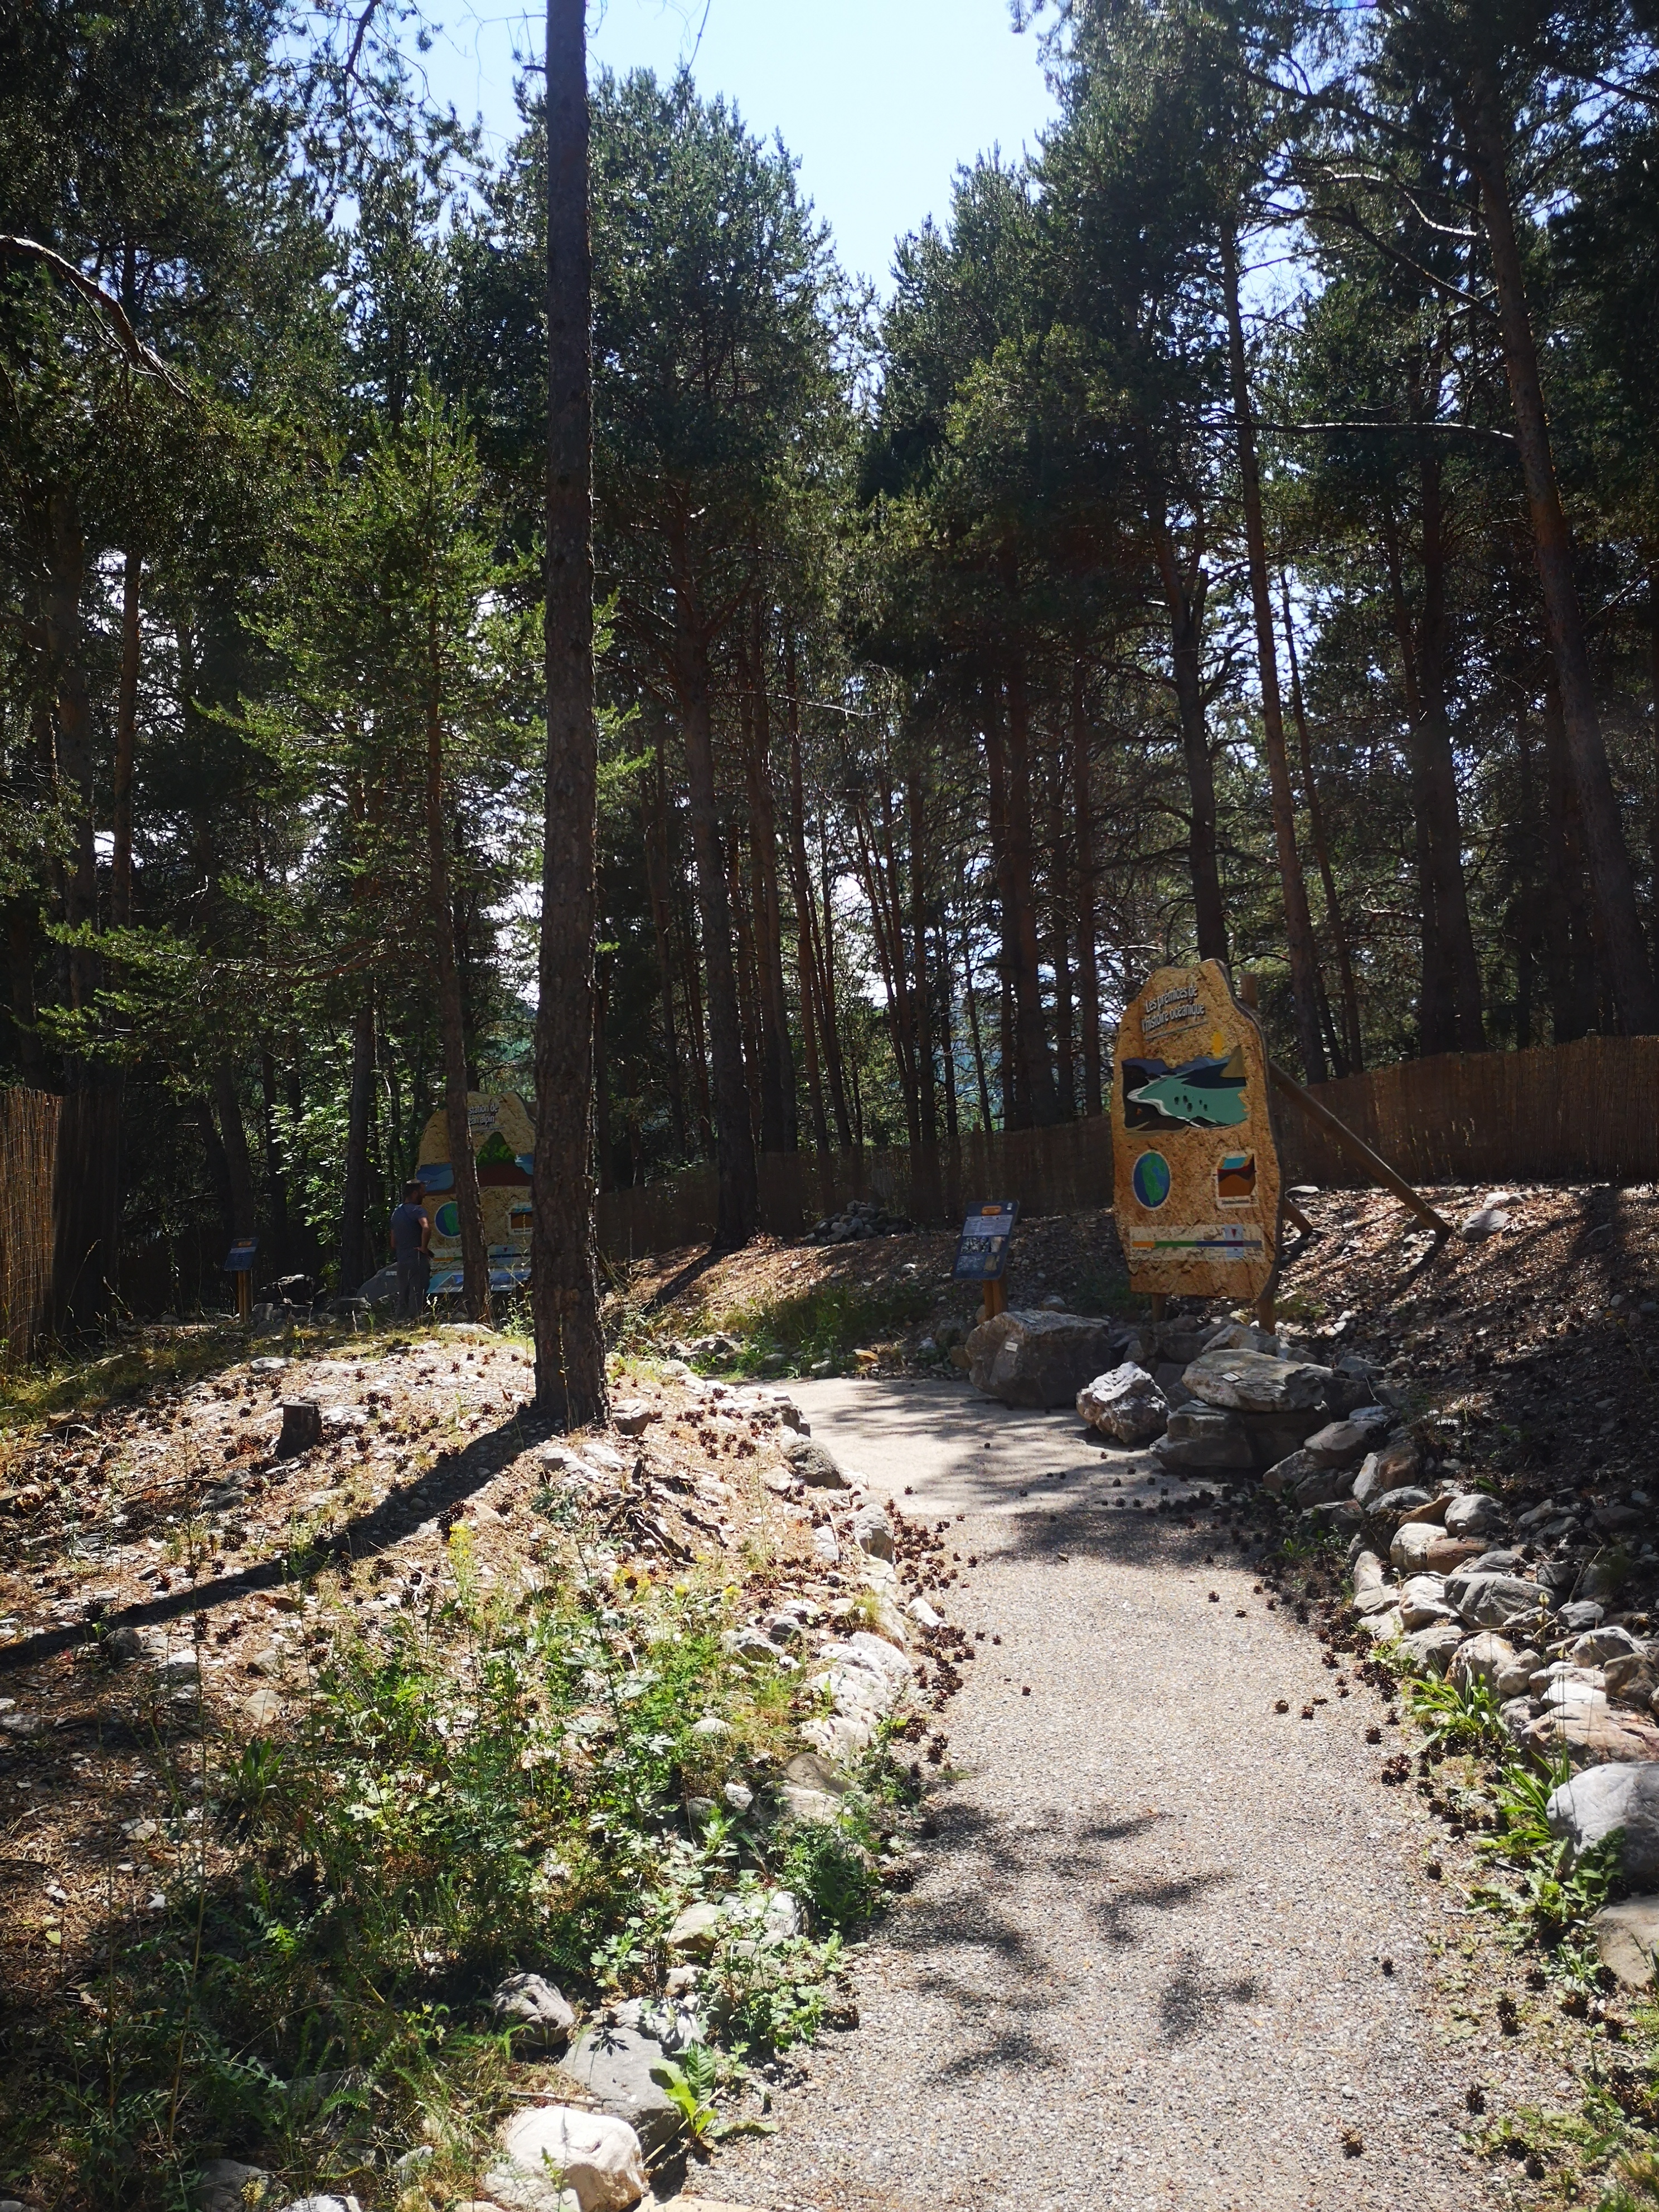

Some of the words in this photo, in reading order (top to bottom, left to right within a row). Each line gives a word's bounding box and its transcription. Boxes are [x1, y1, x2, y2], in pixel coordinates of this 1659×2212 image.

[1145, 999, 1157, 1013] Les
[1157, 987, 1187, 1011] prémices
[1189, 982, 1198, 997] de
[1141, 1011, 1169, 1034] l'histoire
[1170, 1002, 1205, 1020] océanique
[468, 1105, 489, 1114] station
[490, 1103, 498, 1112] de
[480, 1114, 495, 1126] alpin
